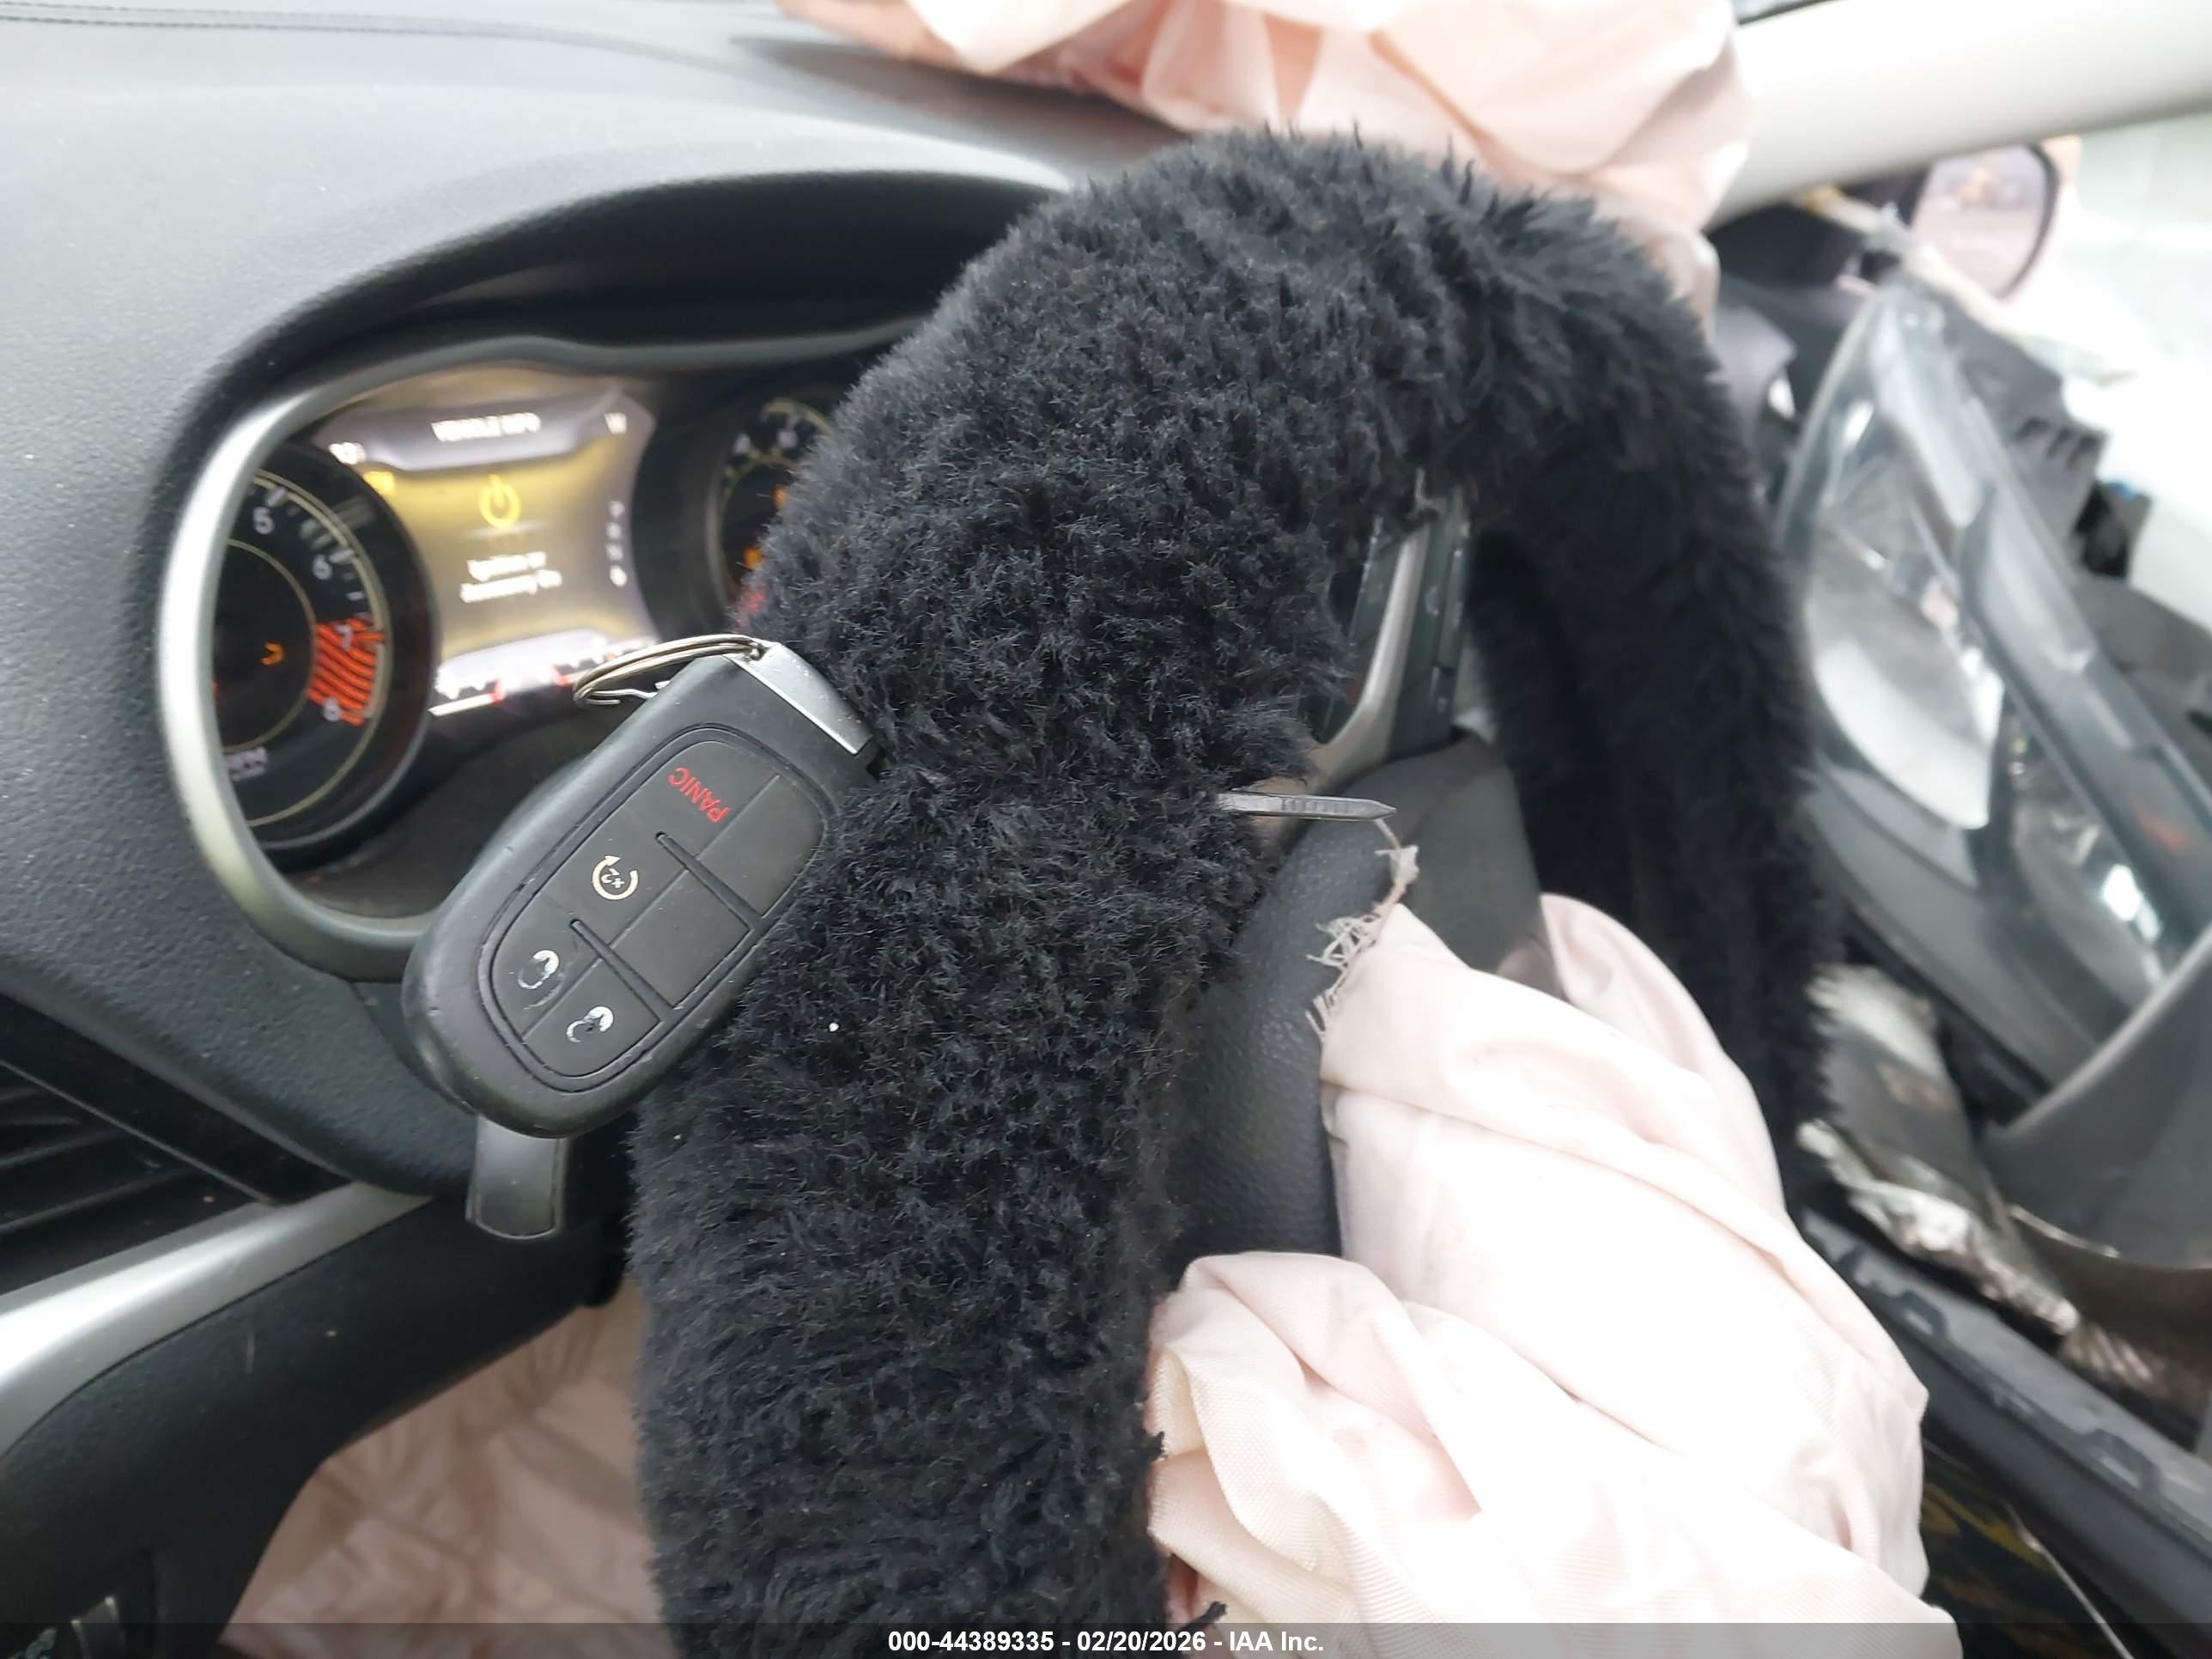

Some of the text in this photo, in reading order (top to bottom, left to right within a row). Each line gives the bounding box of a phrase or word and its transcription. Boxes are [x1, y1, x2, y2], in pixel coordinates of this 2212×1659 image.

[252, 507, 275, 535] 5
[313, 554, 333, 580] 6
[668, 766, 729, 823] PANIC
